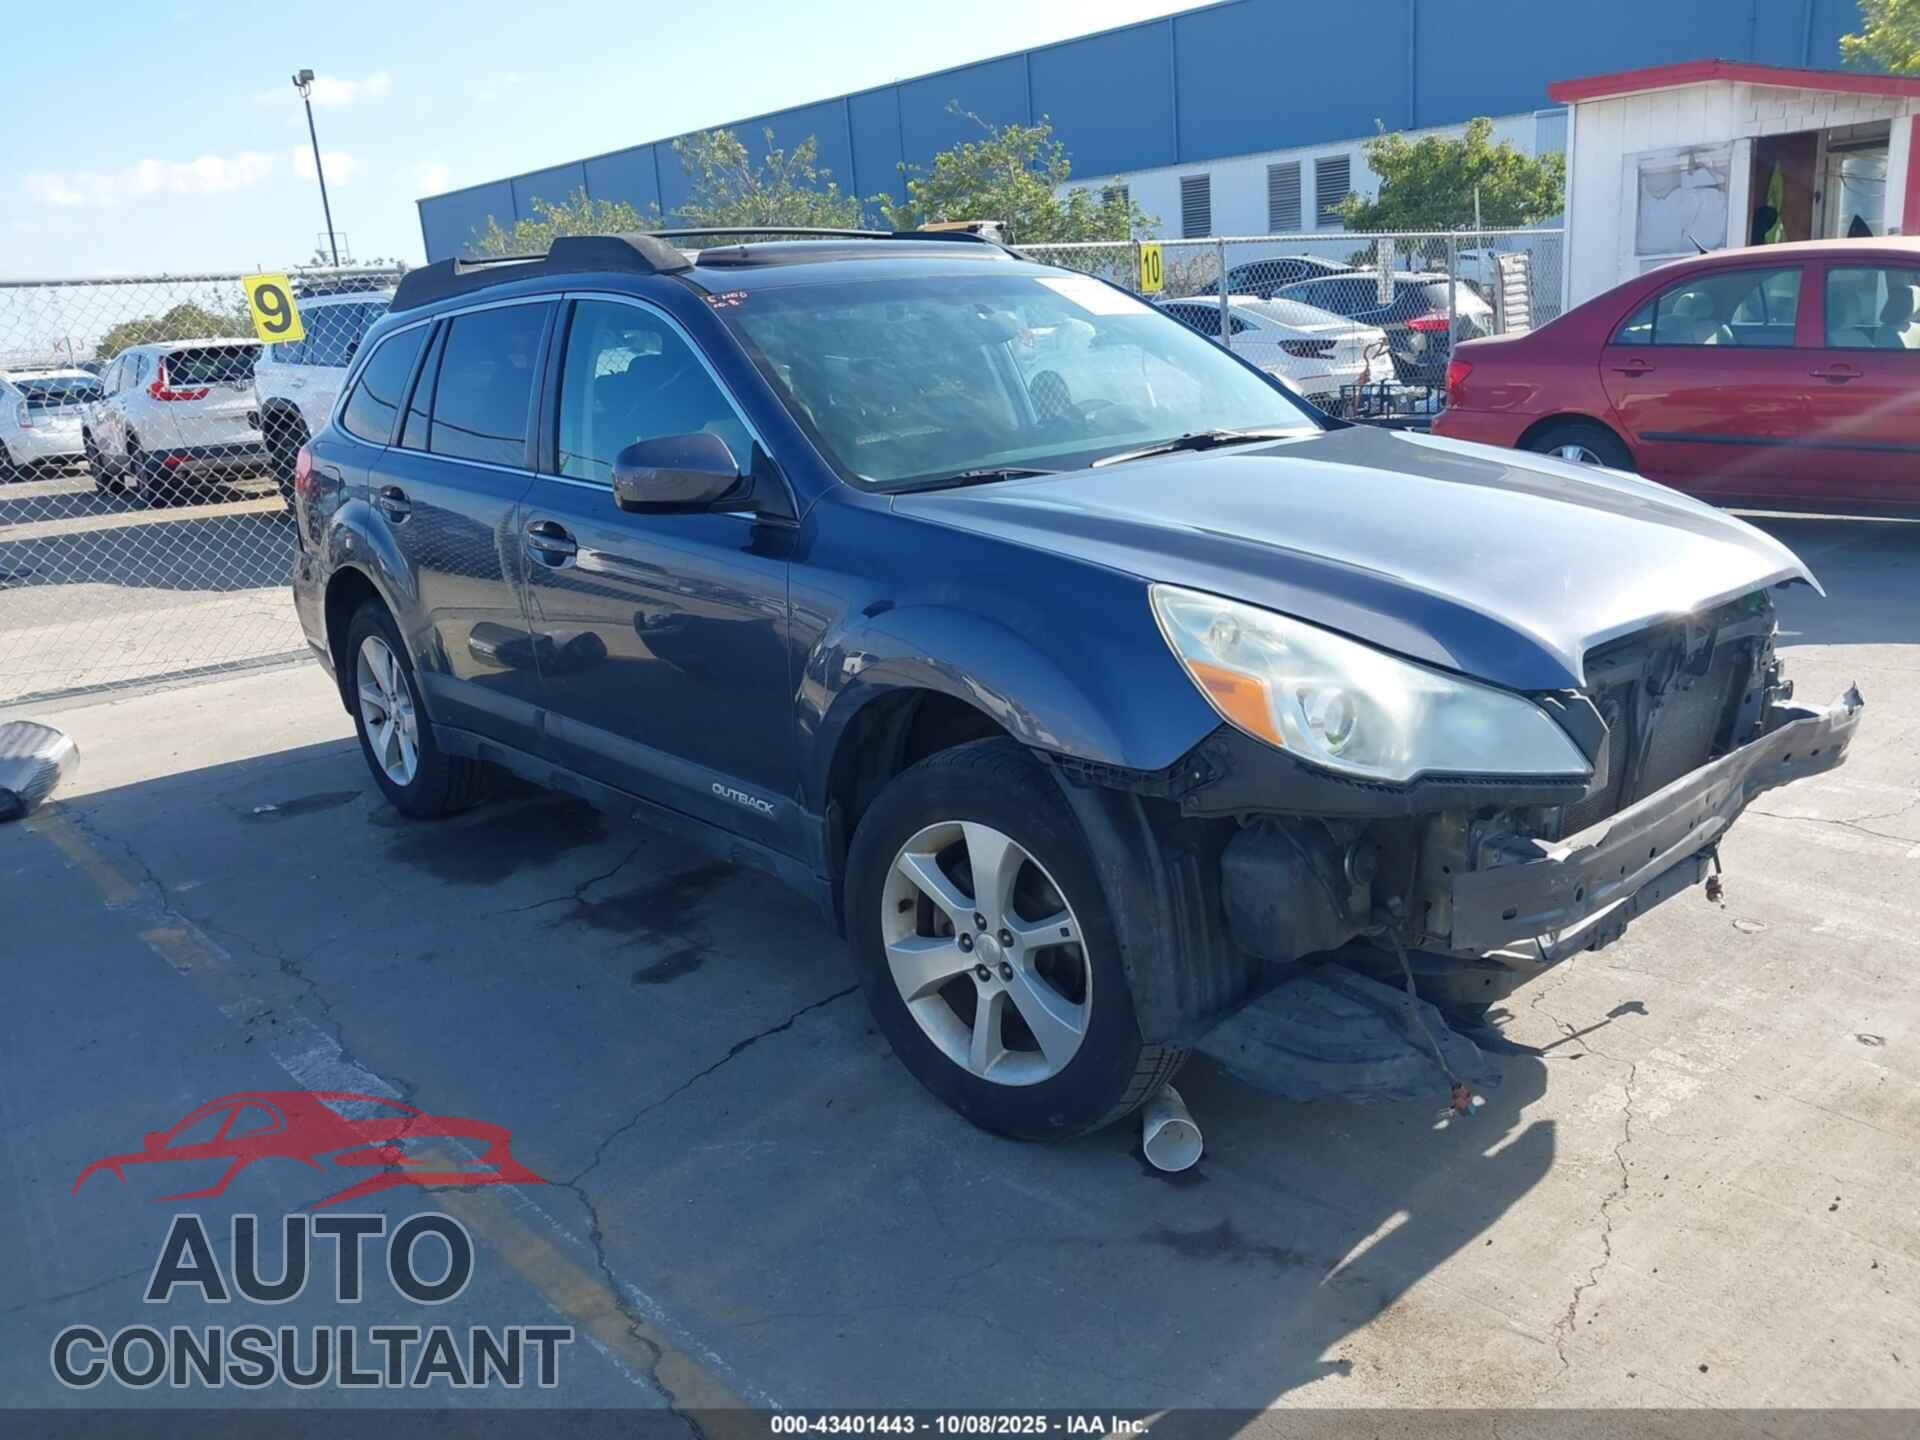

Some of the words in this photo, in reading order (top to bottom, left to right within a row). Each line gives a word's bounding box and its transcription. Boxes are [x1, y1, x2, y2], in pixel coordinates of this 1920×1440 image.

[1143, 250, 1160, 284] 10
[254, 283, 292, 334] 9
[712, 782, 775, 816] OUTBACK
